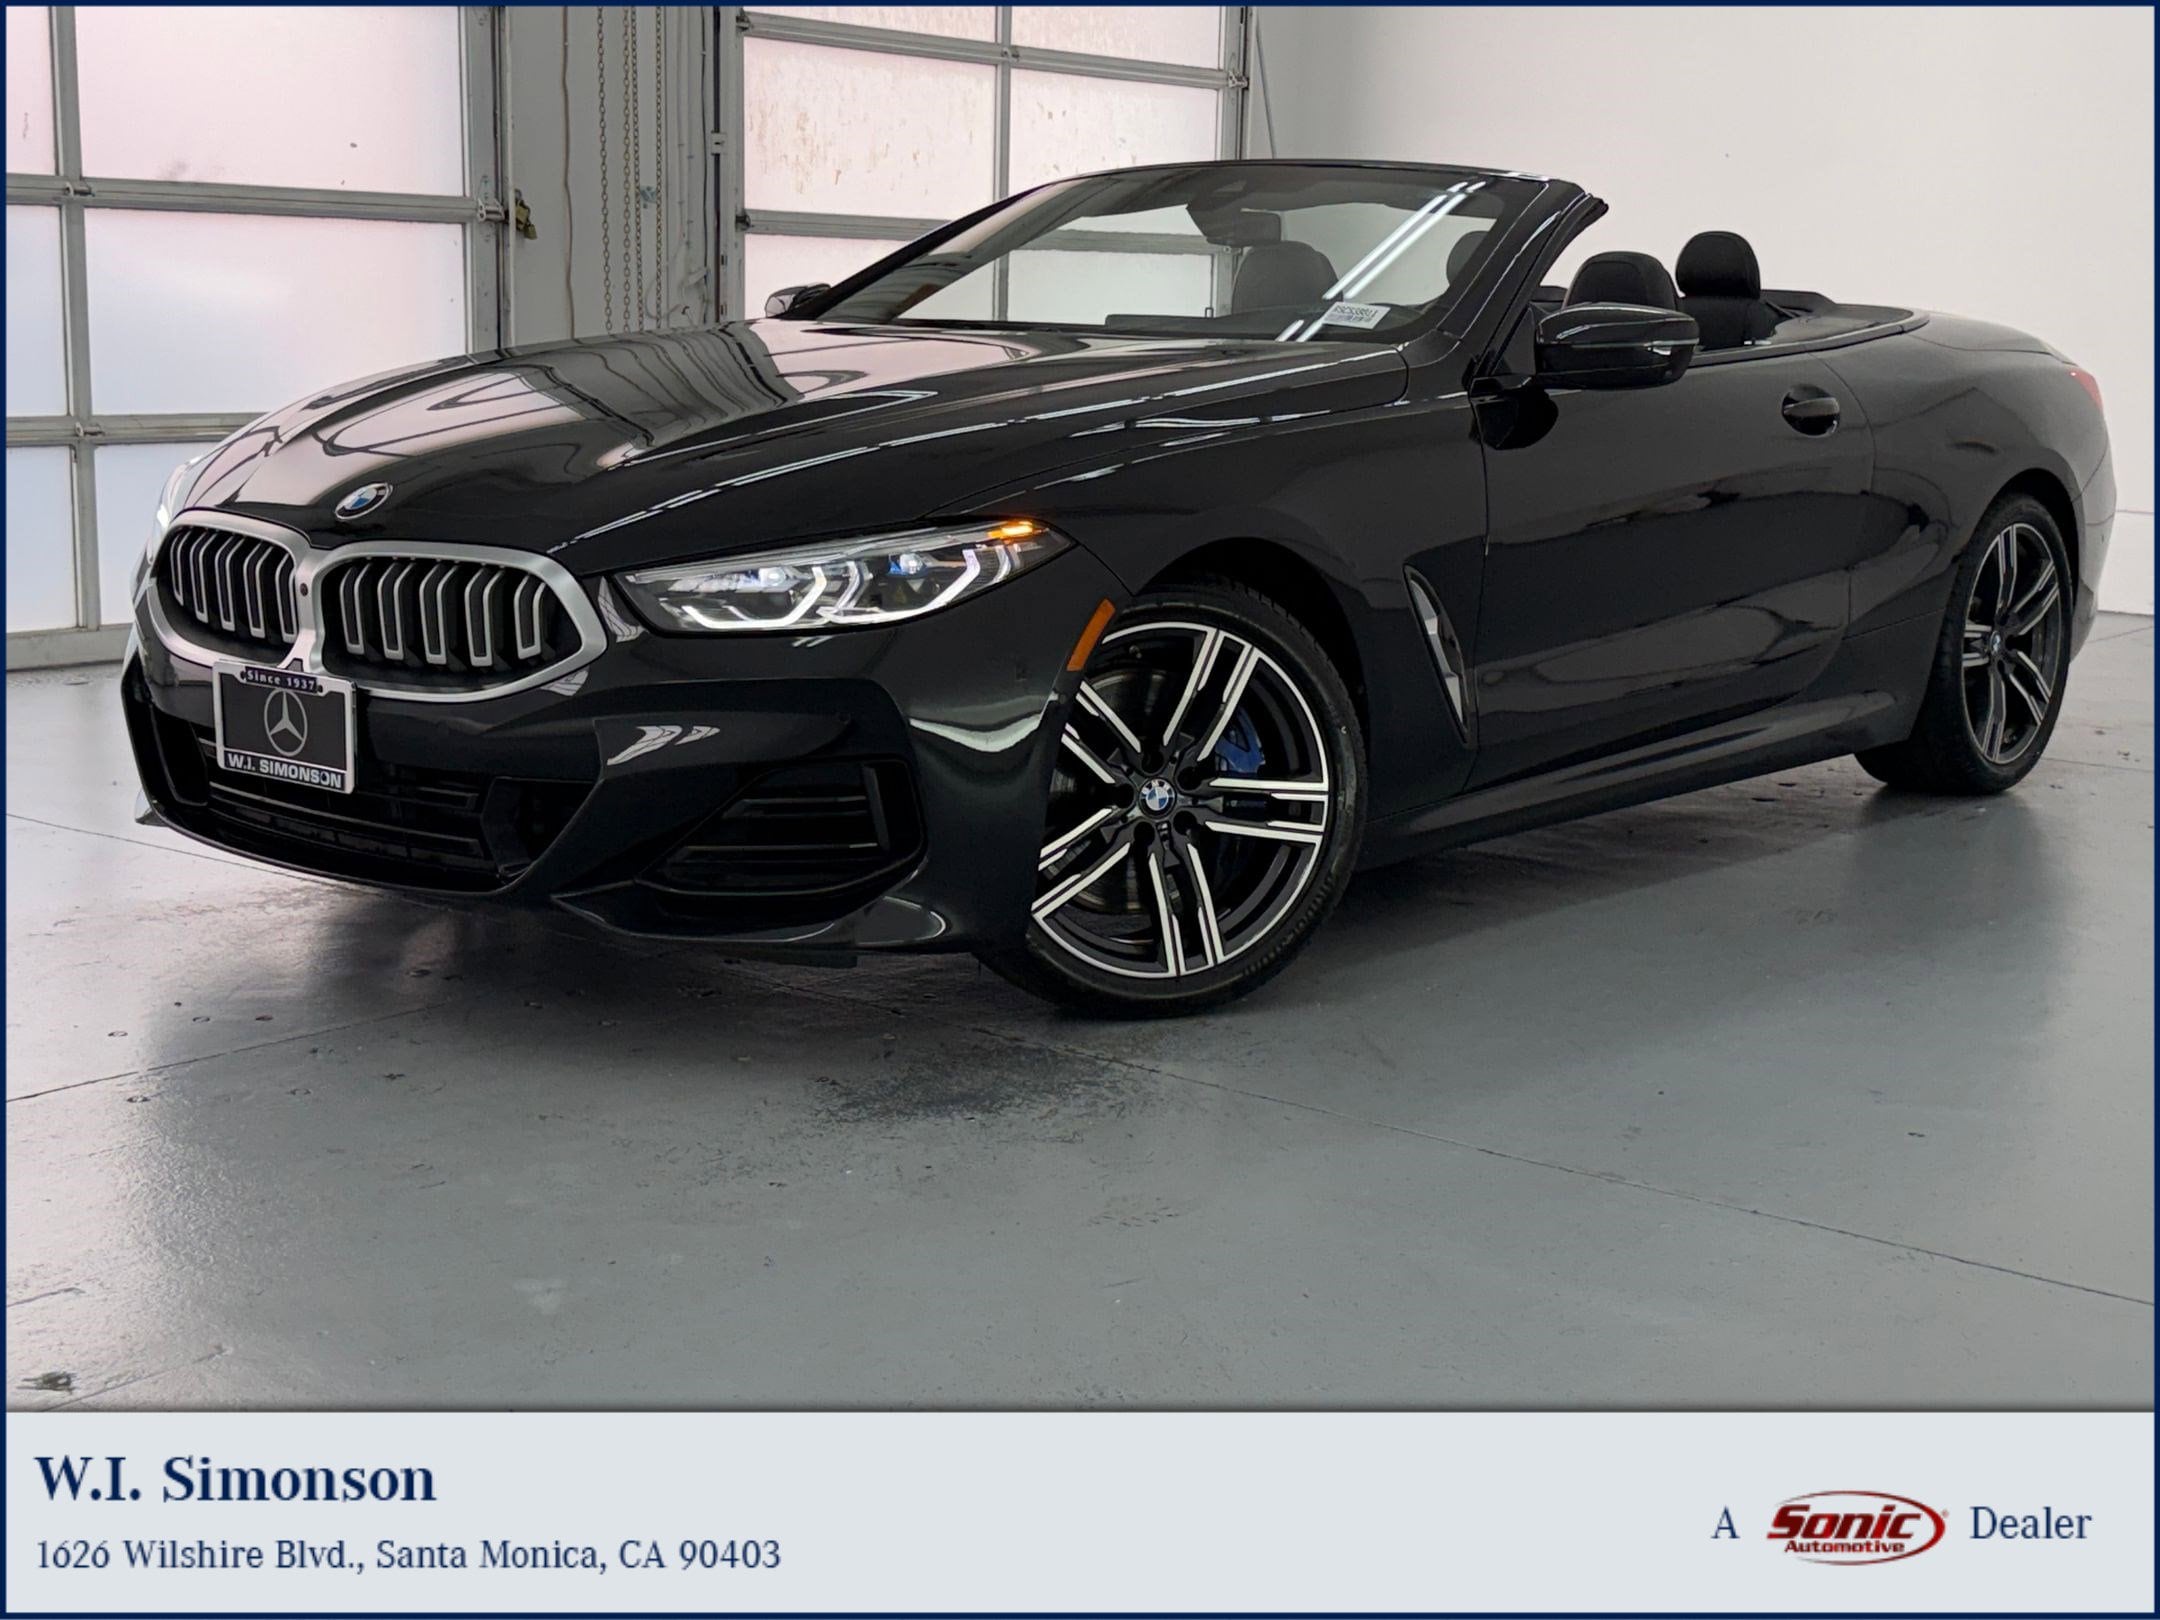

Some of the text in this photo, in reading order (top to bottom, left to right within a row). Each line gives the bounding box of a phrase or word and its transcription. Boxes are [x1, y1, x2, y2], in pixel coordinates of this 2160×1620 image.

[247, 670, 315, 690] Since 1937
[227, 752, 342, 789] W.I. SIMONSON
